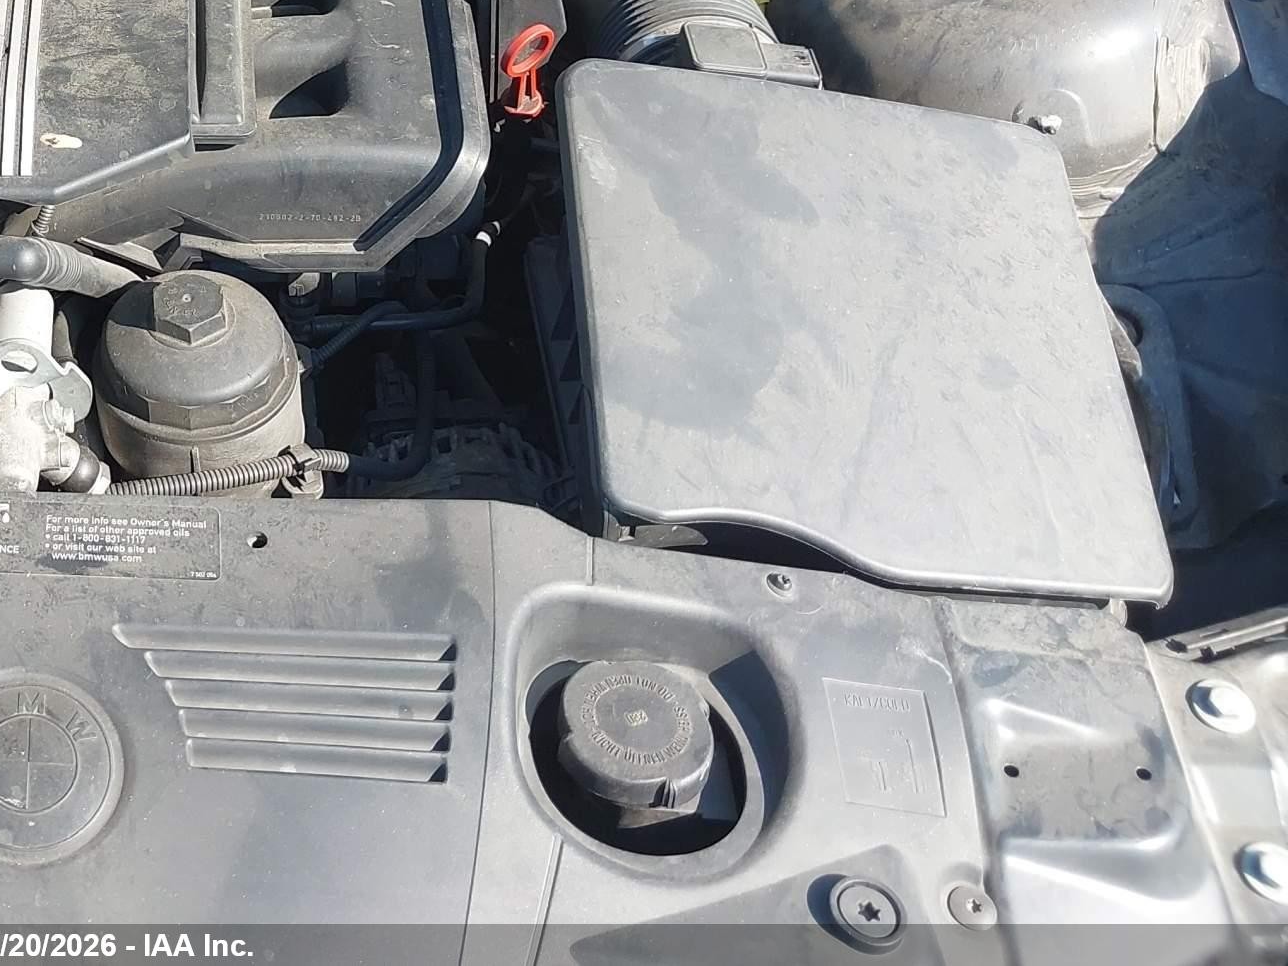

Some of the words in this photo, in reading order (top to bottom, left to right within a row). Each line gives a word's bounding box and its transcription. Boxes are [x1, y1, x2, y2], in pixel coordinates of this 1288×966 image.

[46, 515, 63, 524] For
[64, 516, 89, 524] more
[172, 519, 207, 529] Manual
[45, 524, 62, 532] For
[73, 524, 86, 532] list
[89, 525, 98, 533] of
[100, 525, 125, 534] other
[127, 527, 171, 536] approved
[173, 528, 191, 537] oils
[53, 533, 70, 541] call
[65, 542, 85, 552] visit
[87, 544, 103, 552] our
[105, 544, 125, 552] web
[128, 545, 145, 553] site
[147, 546, 157, 554] at
[591, 730, 623, 760] NICHT
